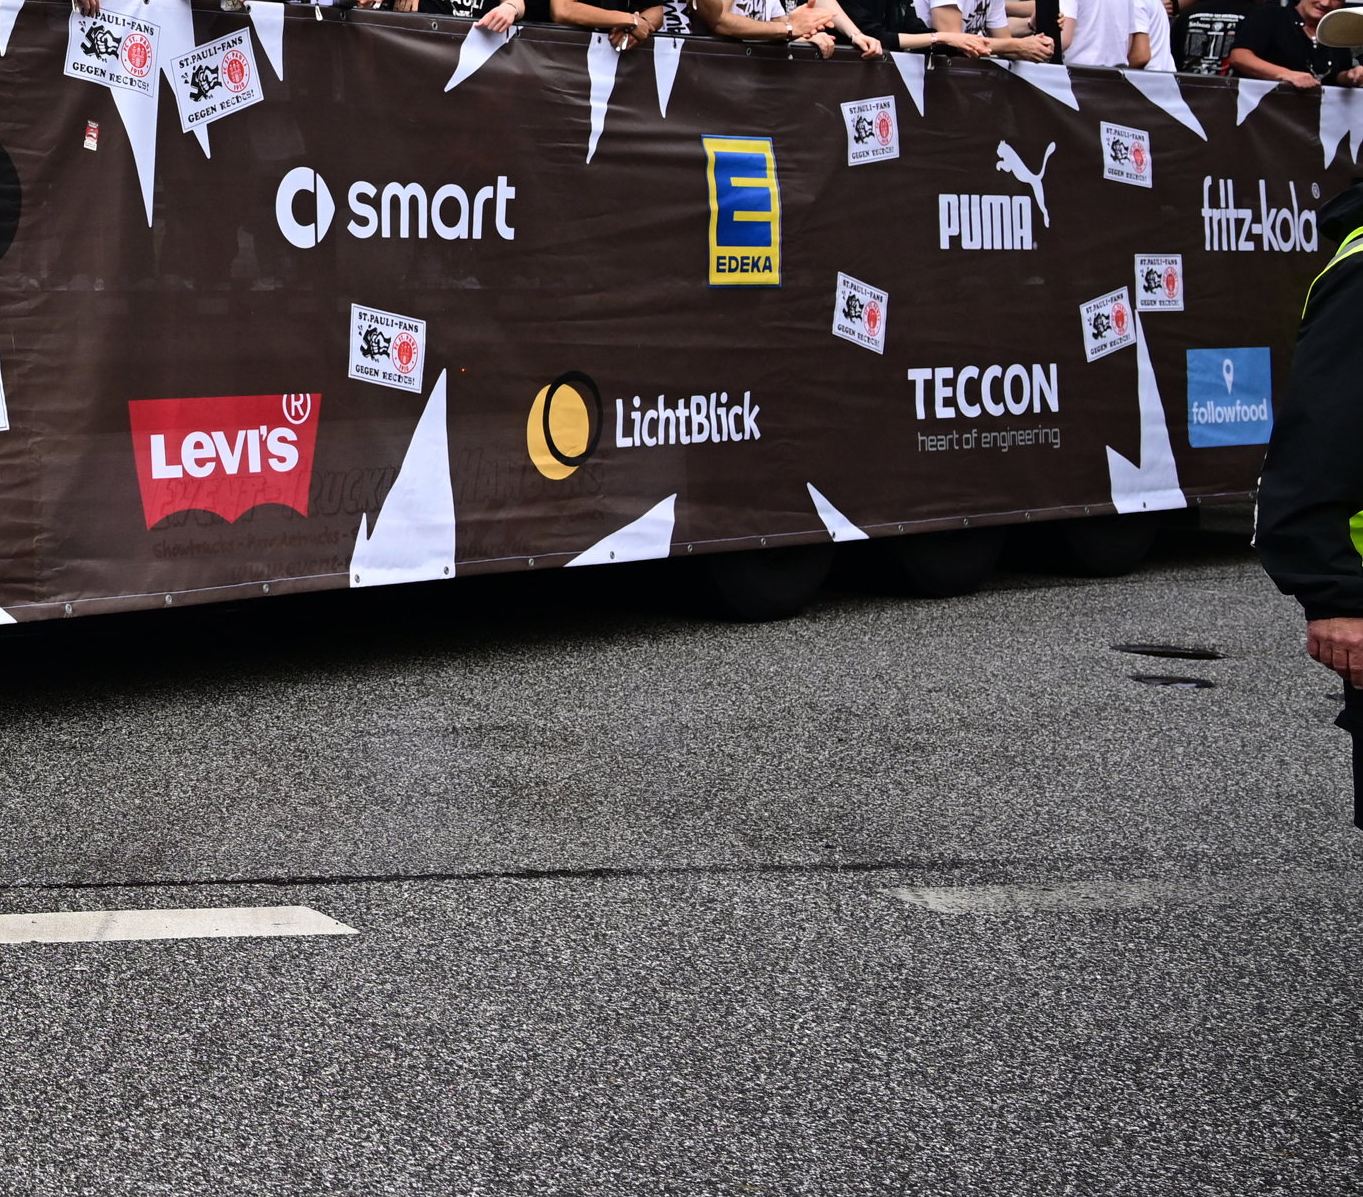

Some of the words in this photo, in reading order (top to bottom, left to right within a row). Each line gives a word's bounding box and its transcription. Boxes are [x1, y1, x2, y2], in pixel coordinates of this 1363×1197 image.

[179, 36, 243, 69] ST.PAULI-FANS
[73, 62, 106, 78] GEGEN
[130, 66, 144, 75] 1910
[188, 105, 217, 123] GEGEN
[347, 176, 516, 241] smart
[1202, 175, 1319, 252] fritz-kola
[939, 194, 1033, 250] PUMA
[716, 255, 773, 274] EDEKA
[358, 311, 419, 334] ST.PAULI-FANS
[355, 364, 380, 378] GEGEN
[907, 363, 1059, 420] TECCON
[615, 391, 761, 448] LichtBlick
[1193, 398, 1268, 424] followfood
[918, 430, 959, 452] heart
[963, 429, 977, 449] of
[982, 425, 1061, 452] engineering
